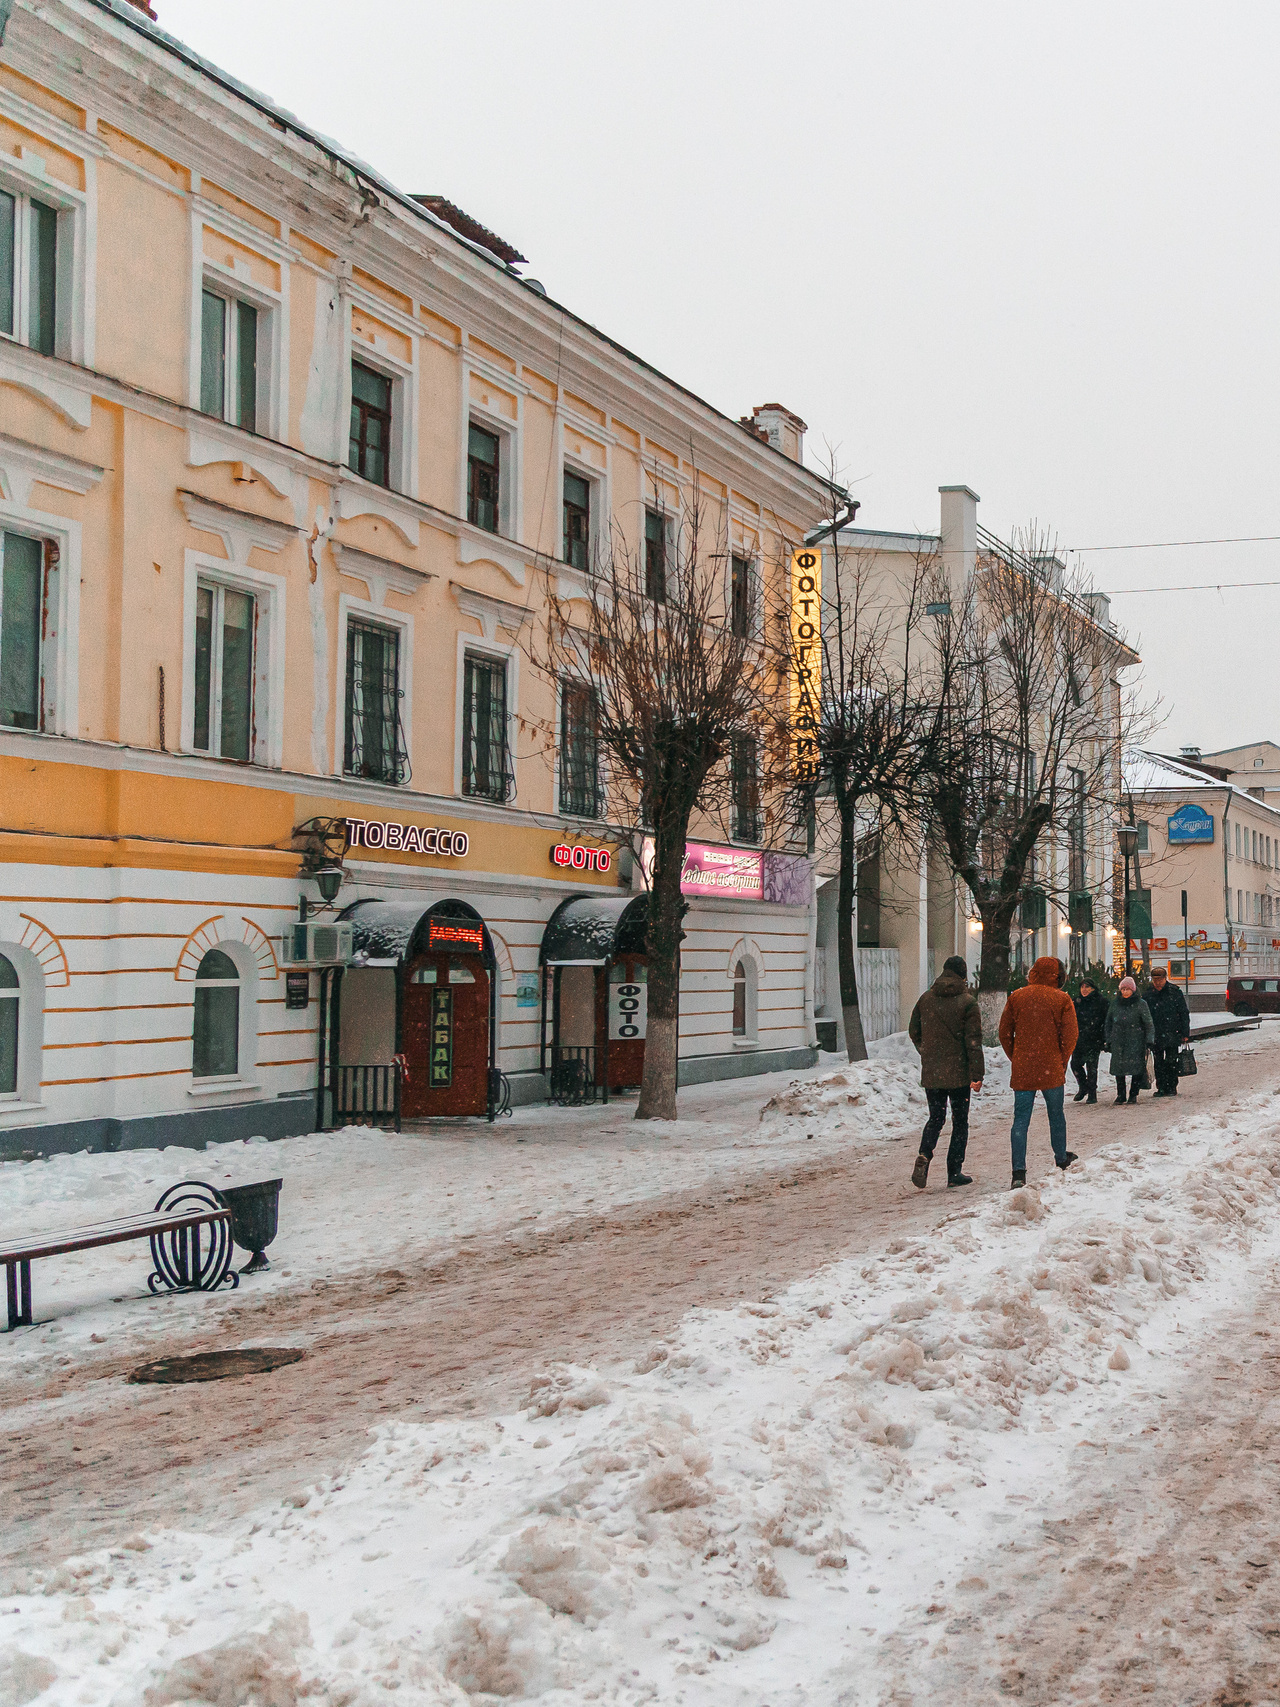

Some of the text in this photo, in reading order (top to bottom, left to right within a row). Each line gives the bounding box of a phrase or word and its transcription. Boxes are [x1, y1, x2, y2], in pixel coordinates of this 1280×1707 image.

[796, 552, 819, 778] ФОТОГРАФИЯ
[345, 817, 470, 858] TOBACCO
[552, 843, 612, 873] ФОТО
[434, 990, 450, 1080] ТАБАК
[617, 985, 641, 1038] ФОТО
